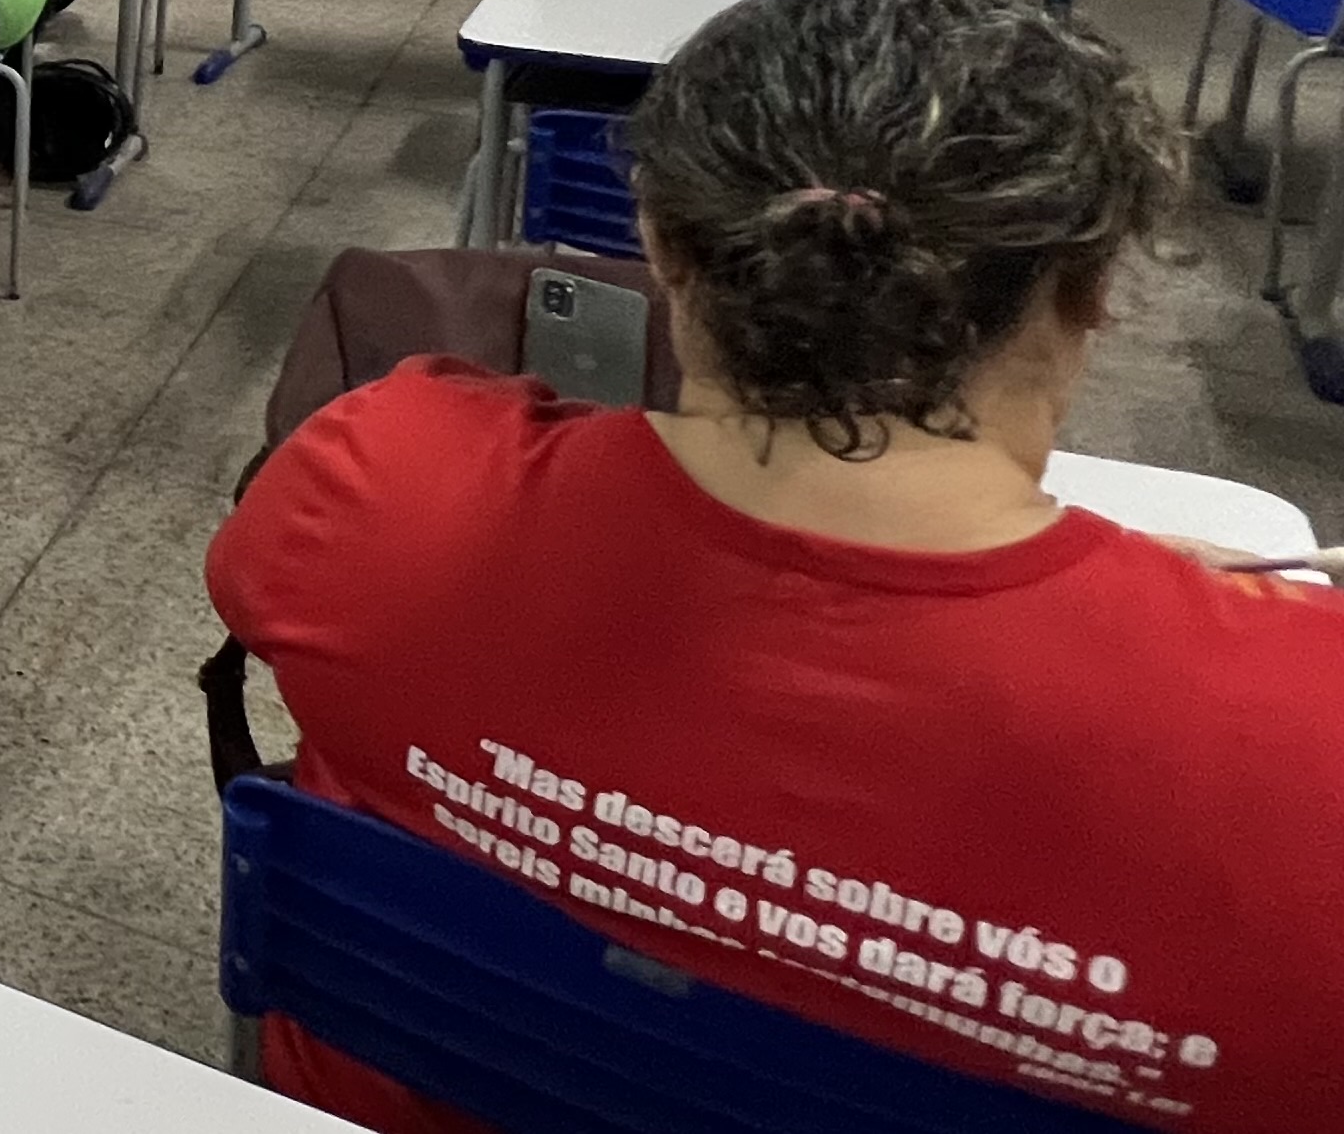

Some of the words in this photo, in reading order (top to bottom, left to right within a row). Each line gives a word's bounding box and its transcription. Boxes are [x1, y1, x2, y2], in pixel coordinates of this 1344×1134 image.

[406, 745, 561, 846] Espírito
[569, 825, 706, 906] Santo
[714, 886, 748, 923] e
[757, 899, 848, 959] vos
[858, 936, 988, 1009] dará
[1178, 1033, 1218, 1068] e
[594, 791, 796, 888] descerá
[805, 867, 965, 945] sobre
[976, 920, 1077, 981] vós
[1087, 954, 1127, 994] o
